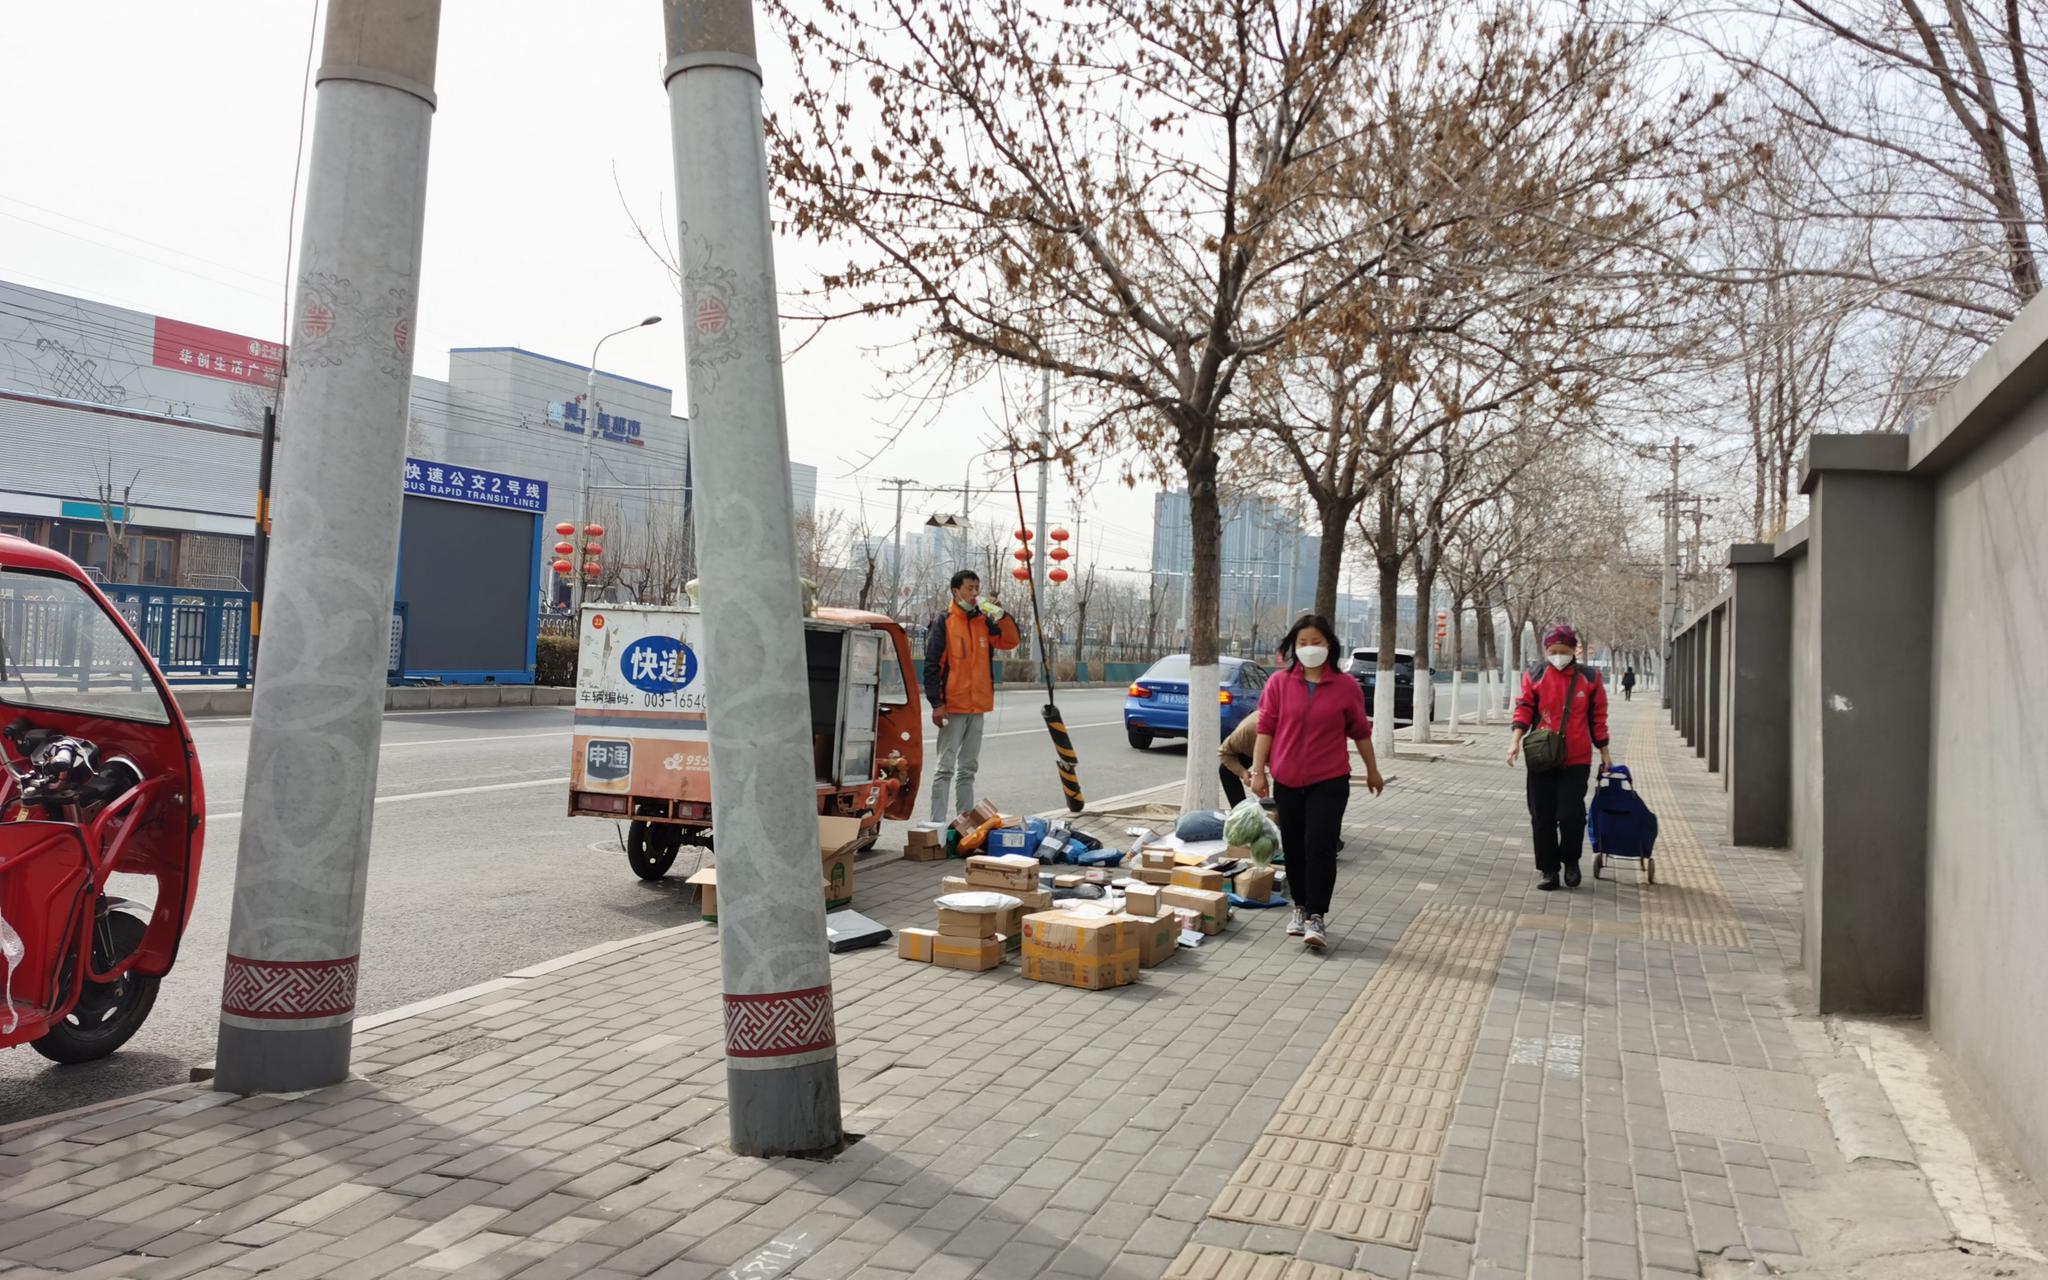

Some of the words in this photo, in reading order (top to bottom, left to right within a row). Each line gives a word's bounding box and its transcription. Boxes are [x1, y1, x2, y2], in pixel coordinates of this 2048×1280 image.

[179, 348, 277, 381] 华创生活广场
[404, 481, 425, 492] BUS
[430, 485, 463, 497] RAPID
[466, 490, 510, 504] TRANSIT
[513, 497, 540, 509] LINE2
[405, 462, 540, 499] 快速公交2号线
[631, 646, 687, 683] 快递
[589, 744, 628, 769] 申通
